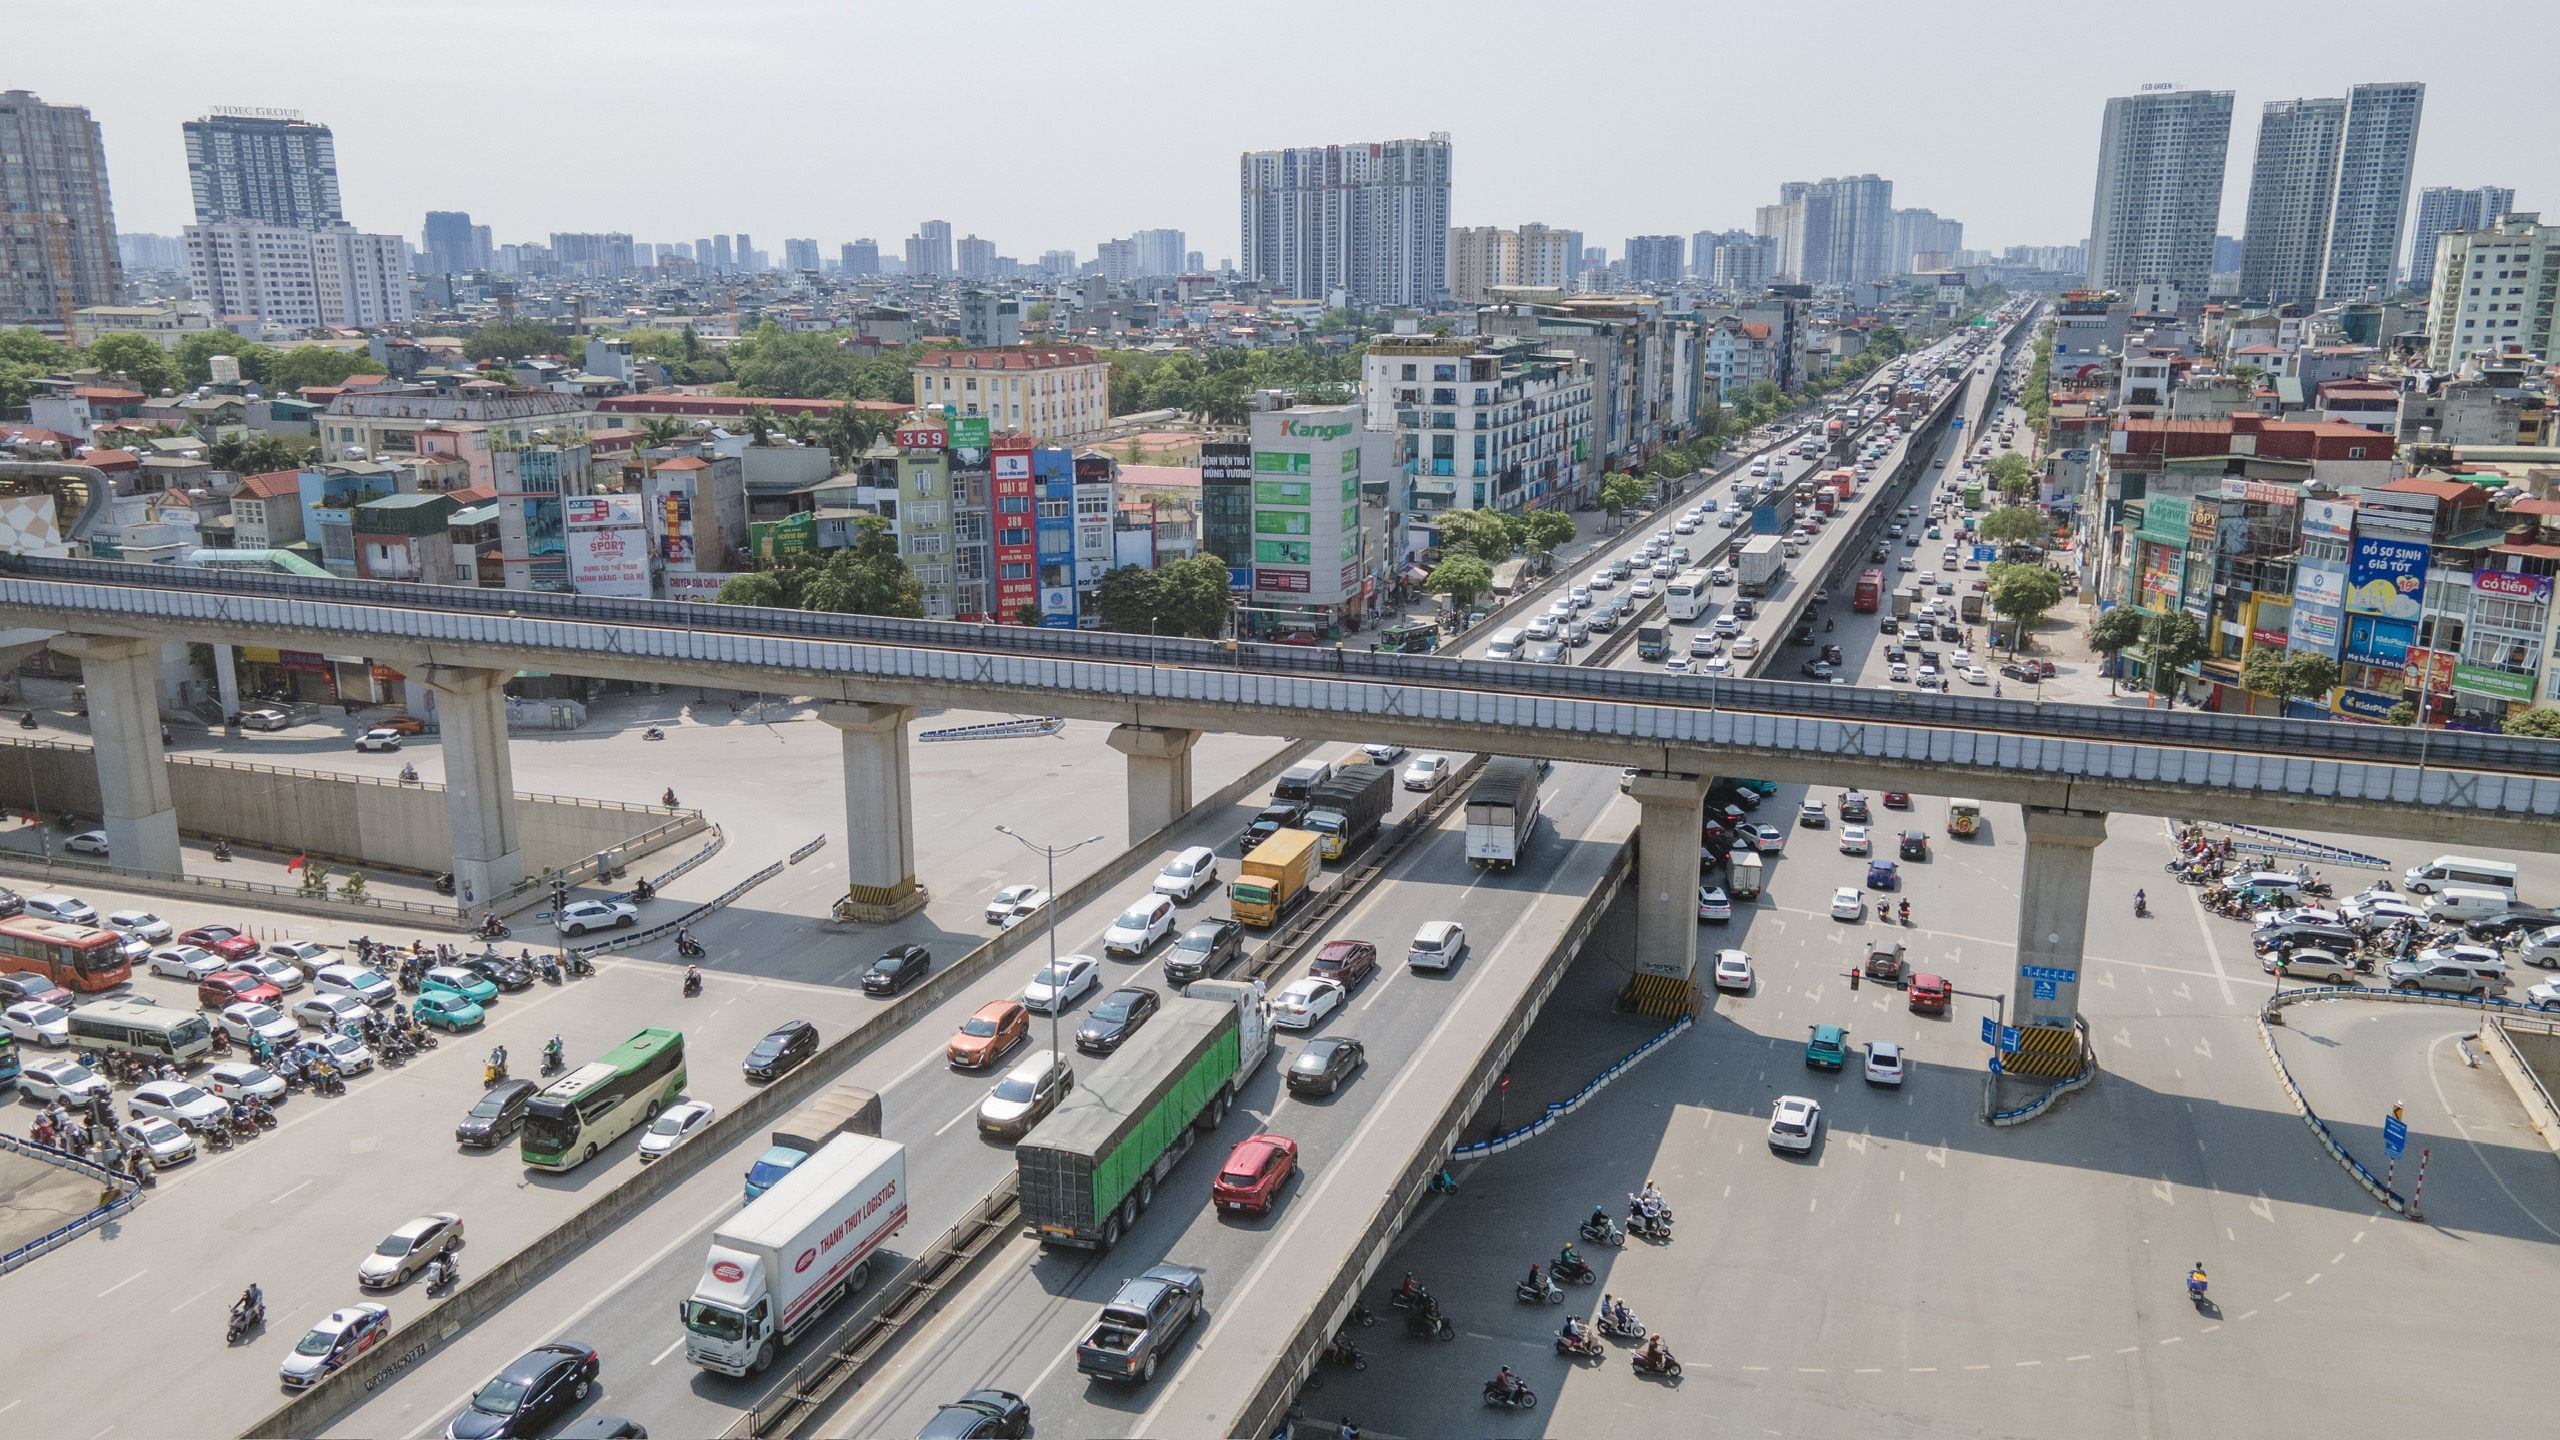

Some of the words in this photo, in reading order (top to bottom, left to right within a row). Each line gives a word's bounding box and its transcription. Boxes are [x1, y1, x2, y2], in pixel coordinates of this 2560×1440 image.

[215, 106, 253, 116] VIDEC
[256, 107, 300, 118] GROUP
[903, 432, 943, 446] 369
[1202, 455, 1218, 467] BỆNH
[1219, 455, 1233, 467] VIỆN
[1234, 455, 1245, 466] THÚ
[1246, 457, 1251, 466] Y
[2068, 450, 2088, 461] Ford
[1204, 467, 1224, 478] HÙNG
[1227, 467, 1251, 478] VƯƠNG
[1000, 480, 1015, 495] LUẬT
[1018, 480, 1028, 493] SƯ
[2149, 502, 2187, 521] Kagawa
[1008, 516, 1022, 527] 369
[2190, 512, 2217, 526] TOPY
[599, 530, 615, 541] 357
[590, 541, 625, 551] SPORT
[2362, 541, 2378, 555] ĐỒ
[2380, 546, 2395, 557] SƠ
[2395, 549, 2422, 561] SINH
[2390, 558, 2412, 572] TỐT
[576, 573, 596, 582] CHÍNH
[598, 572, 617, 581] HÀNG
[624, 571, 635, 580] GIÁ
[2482, 578, 2499, 589] có
[2501, 581, 2528, 594] tiền
[2347, 653, 2358, 662] Mẹ
[820, 1223, 844, 1255] THANH
[863, 1179, 896, 1219] LOGISTICS
